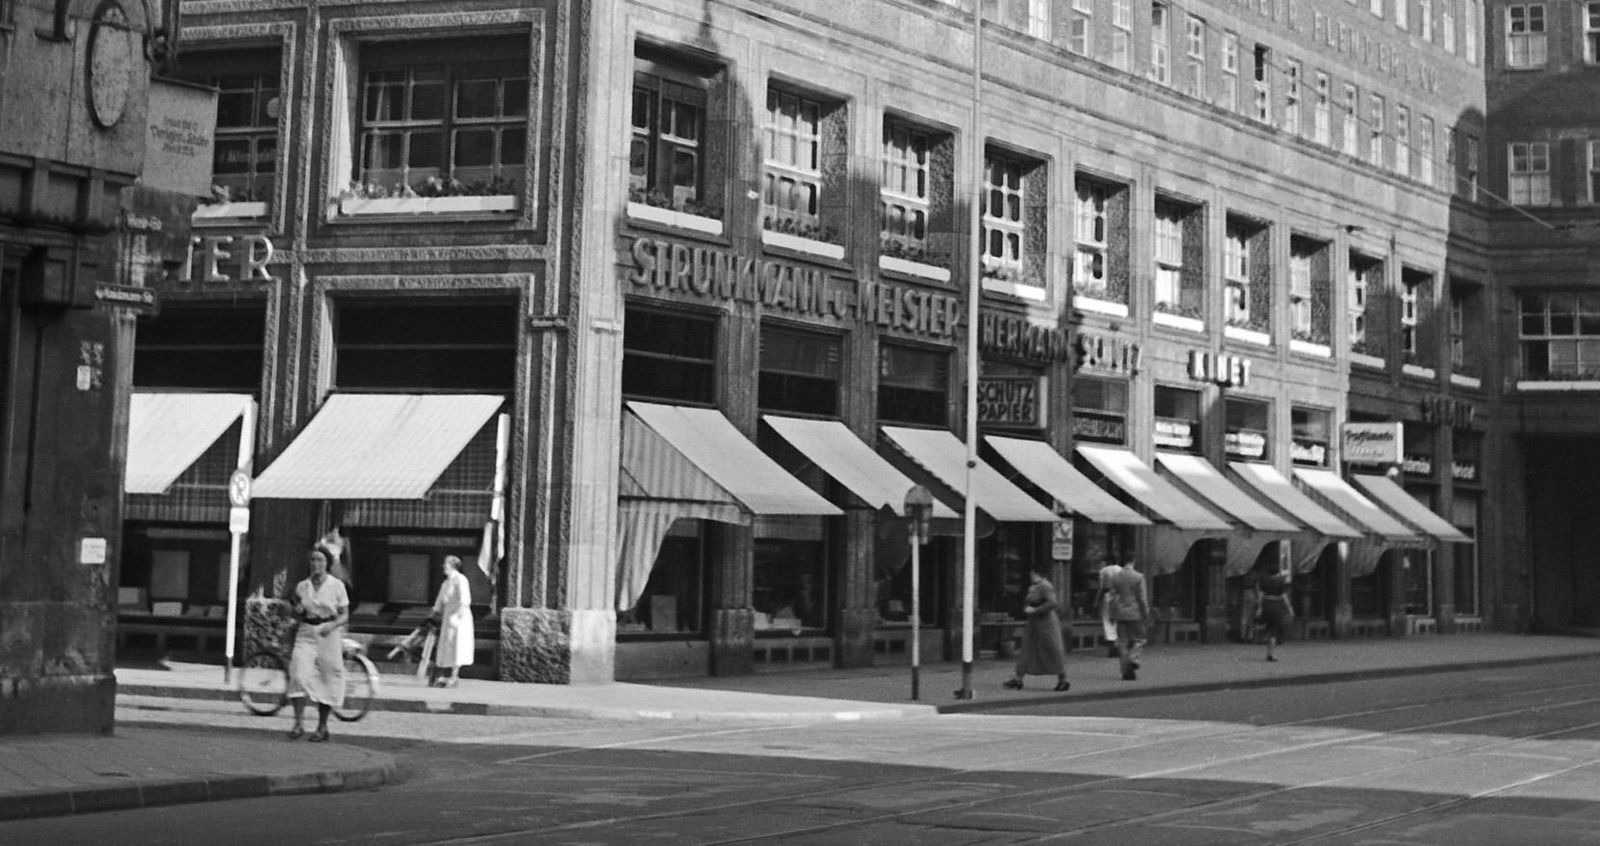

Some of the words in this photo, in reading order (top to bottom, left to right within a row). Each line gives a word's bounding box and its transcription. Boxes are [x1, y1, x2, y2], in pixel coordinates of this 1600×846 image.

[163, 235, 273, 281] TER
[631, 236, 832, 316] STRUNKMANN
[855, 277, 961, 338] MEISTER
[981, 312, 1071, 360] HERMANN
[978, 404, 1032, 421] PAPIER
